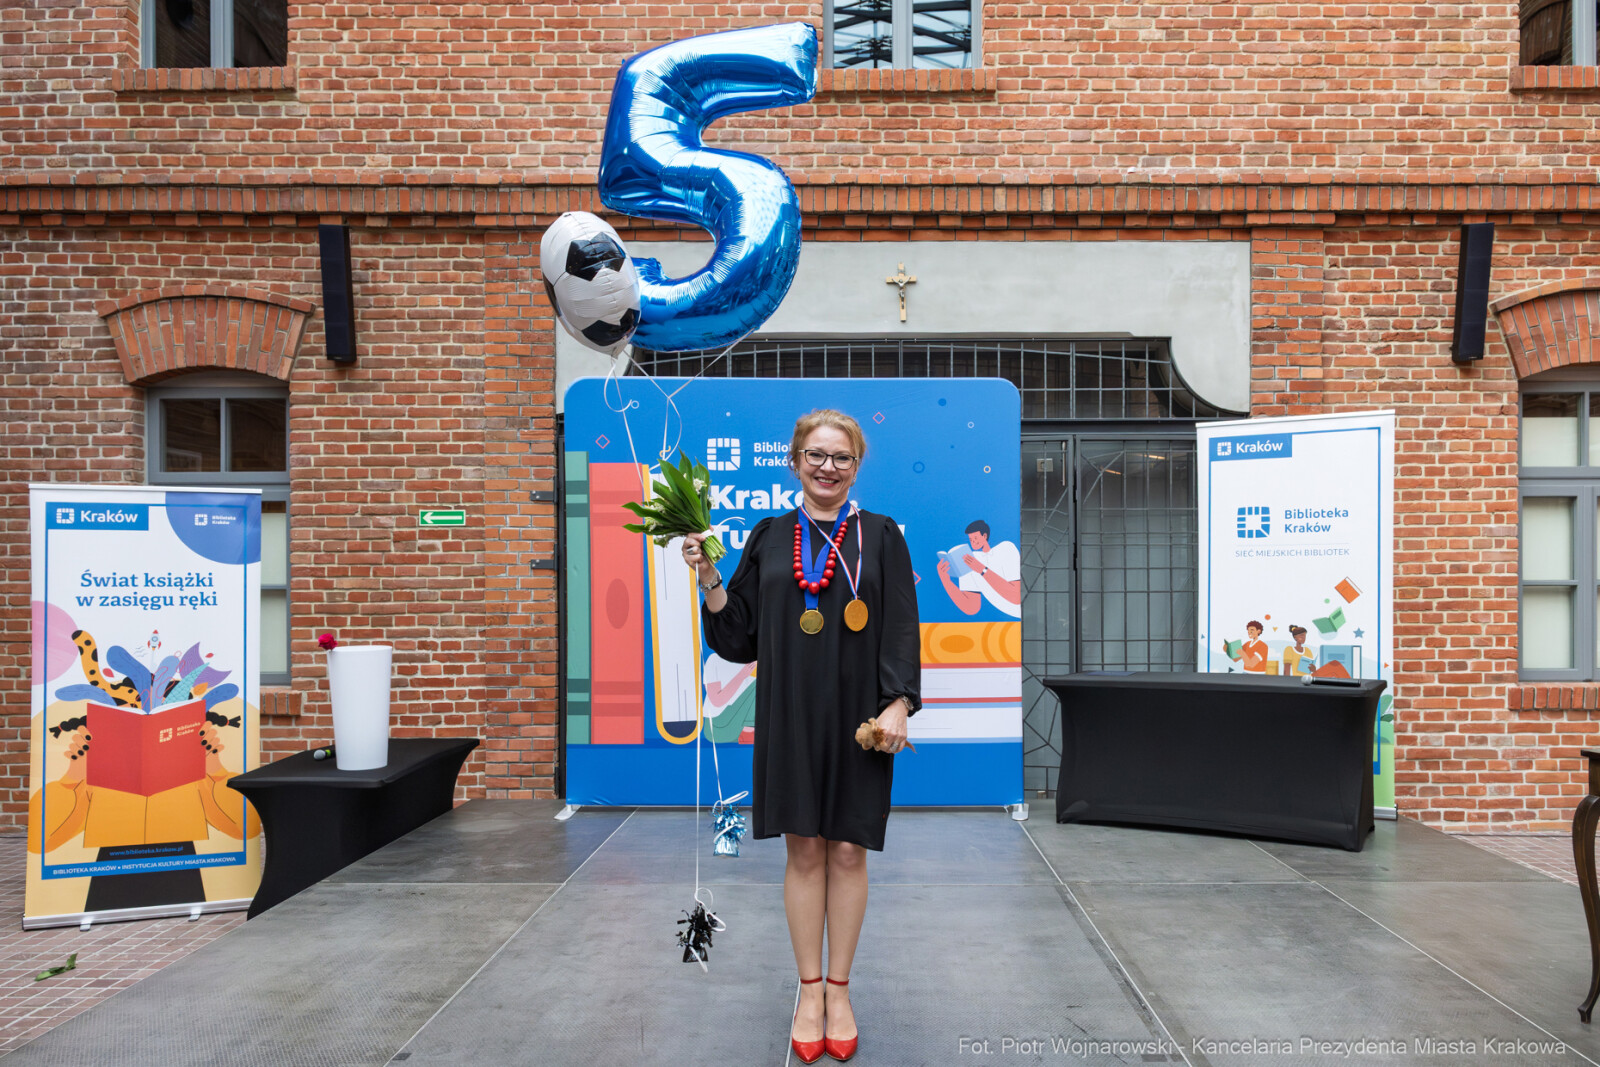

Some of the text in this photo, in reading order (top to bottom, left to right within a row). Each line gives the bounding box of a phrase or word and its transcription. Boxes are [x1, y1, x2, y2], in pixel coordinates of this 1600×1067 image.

[598, 21, 818, 352] 5
[1236, 440, 1284, 453] Kraków
[81, 509, 138, 523] Kraków
[1285, 507, 1349, 519] Biblioteka
[1285, 522, 1331, 533] Kraków
[1256, 549, 1301, 557] MIEJSKICH
[1304, 548, 1350, 556] BIBLIOTEK
[80, 569, 214, 591] Świat książki
[76, 591, 218, 610] w zasięgu ręki
[53, 856, 236, 875] BIBLIOTEKA KRAKÓW INSTYTUCJA KULTURY MIASTA KRAKOWA
